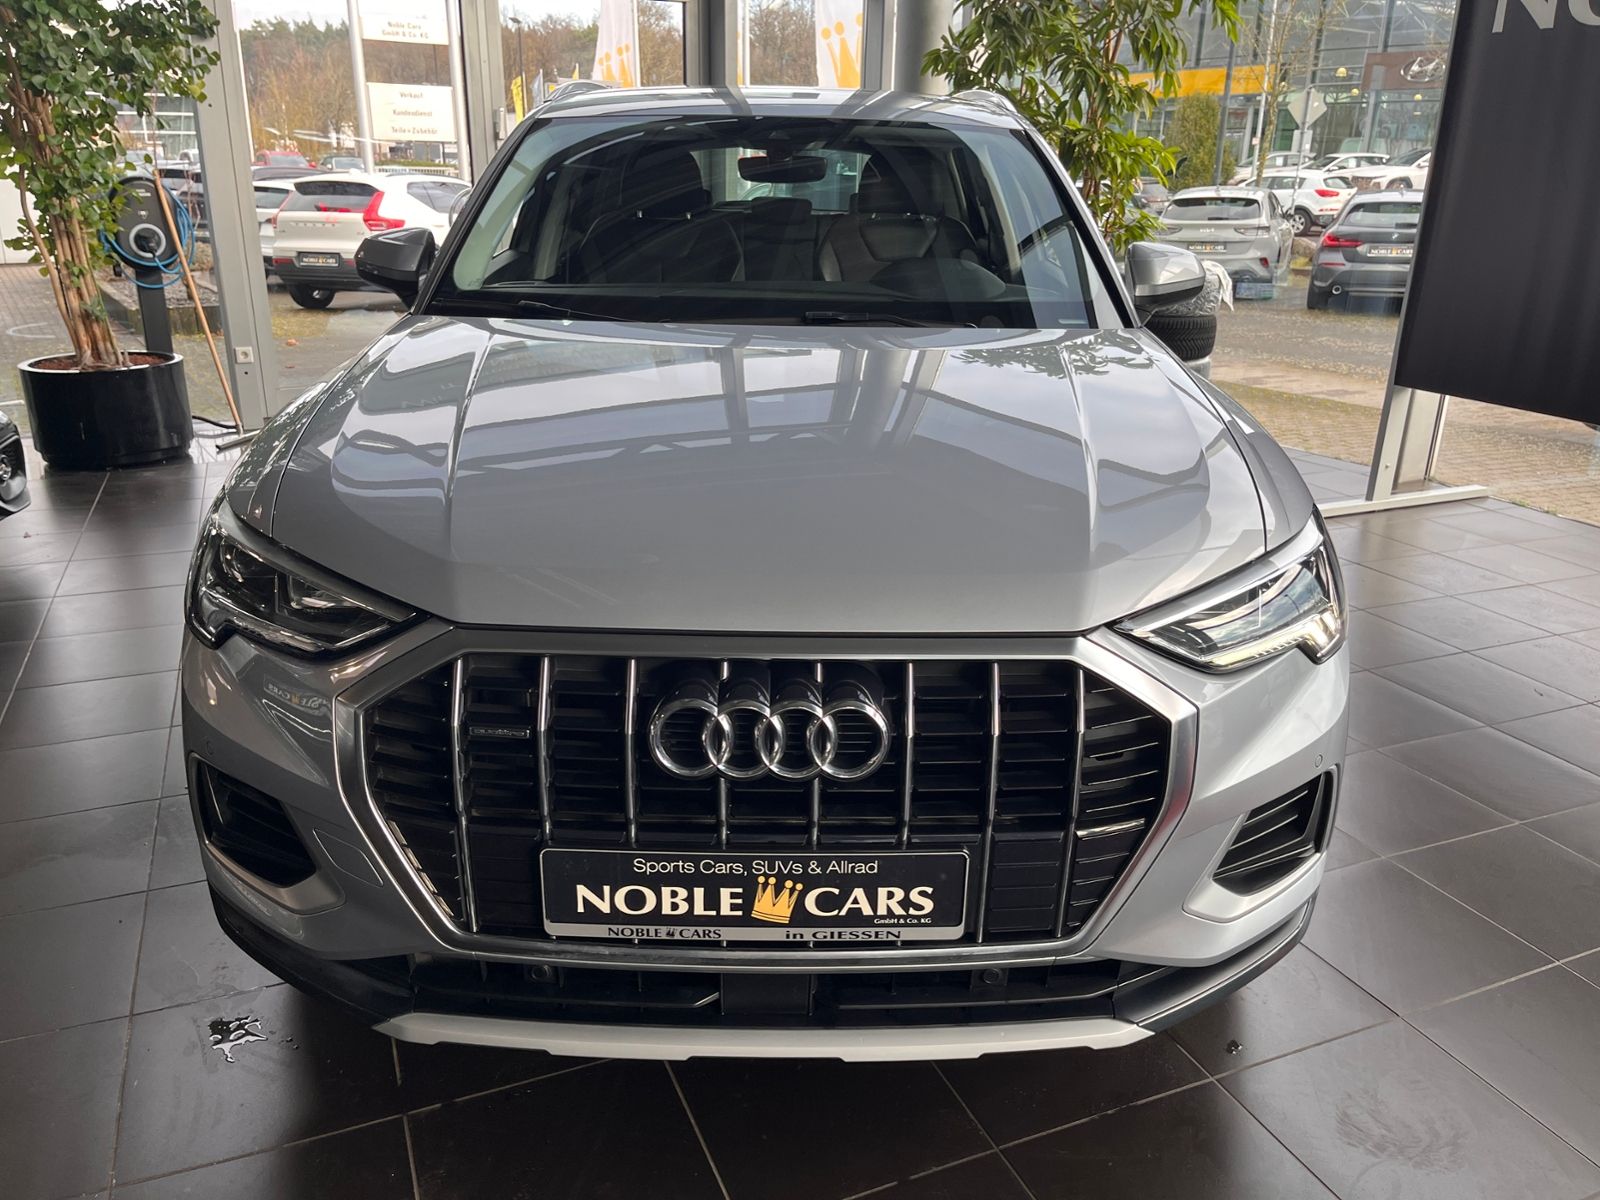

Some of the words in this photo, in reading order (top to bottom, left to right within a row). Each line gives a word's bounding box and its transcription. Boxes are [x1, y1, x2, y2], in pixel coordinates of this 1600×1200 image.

[1491, 0, 1600, 33] N
[393, 109, 433, 117] Kundendienst
[633, 857, 695, 876] Sports
[699, 859, 748, 877] Cars,
[751, 860, 803, 874] SUVs
[807, 860, 822, 875] &
[826, 860, 878, 874] Allrad
[575, 884, 744, 916] NOBLE
[804, 886, 935, 917] CARS
[607, 927, 662, 938] NOBLE
[679, 928, 722, 939] CARS
[785, 930, 804, 940] in
[812, 930, 902, 940] GIESSEN
